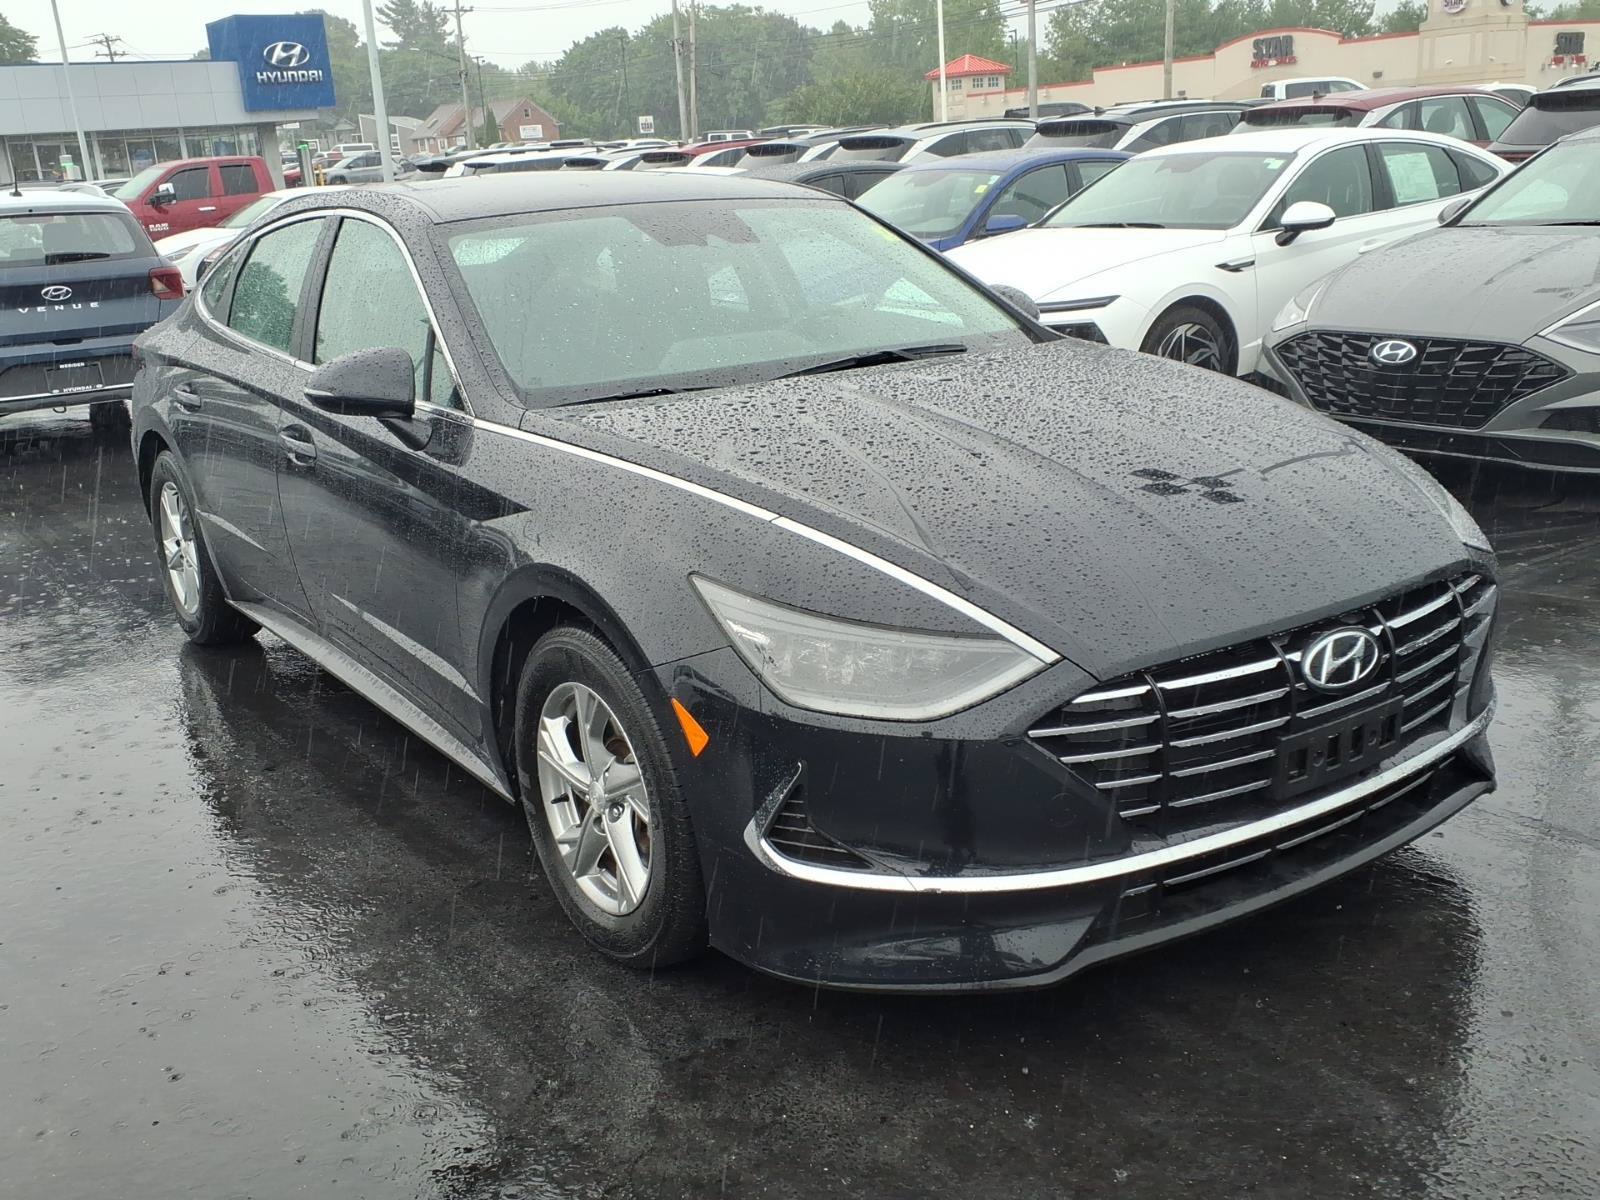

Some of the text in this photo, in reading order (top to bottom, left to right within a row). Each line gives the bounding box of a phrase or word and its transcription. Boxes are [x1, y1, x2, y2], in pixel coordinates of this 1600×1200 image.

[1253, 35, 1293, 59] STAR
[256, 70, 323, 83] HYUNDAI
[18, 302, 99, 313] VENUE
[63, 385, 92, 393] HYUNDAI
